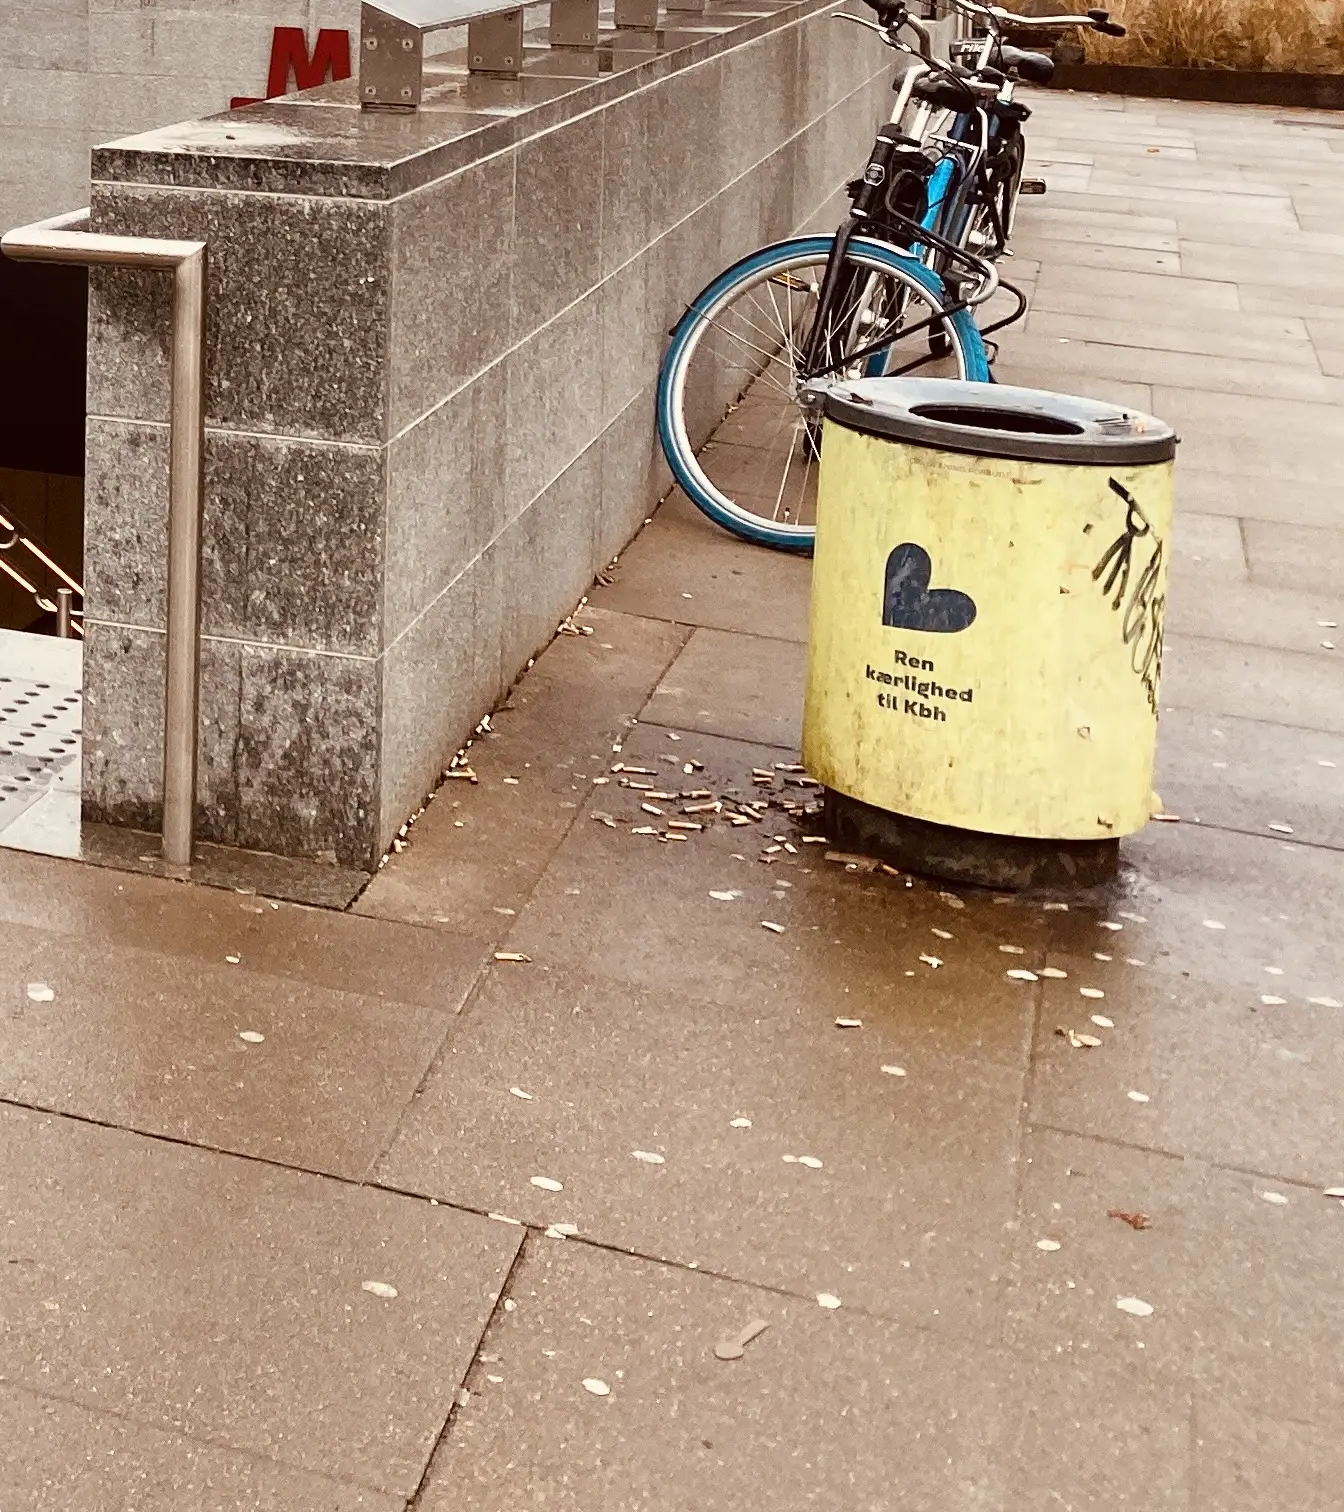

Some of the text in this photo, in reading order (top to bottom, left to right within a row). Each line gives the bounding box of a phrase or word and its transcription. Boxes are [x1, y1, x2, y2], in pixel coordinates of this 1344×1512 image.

[894, 649, 934, 672] Ren
[865, 664, 973, 703] kærlighed
[877, 693, 946, 722] til Kbh
